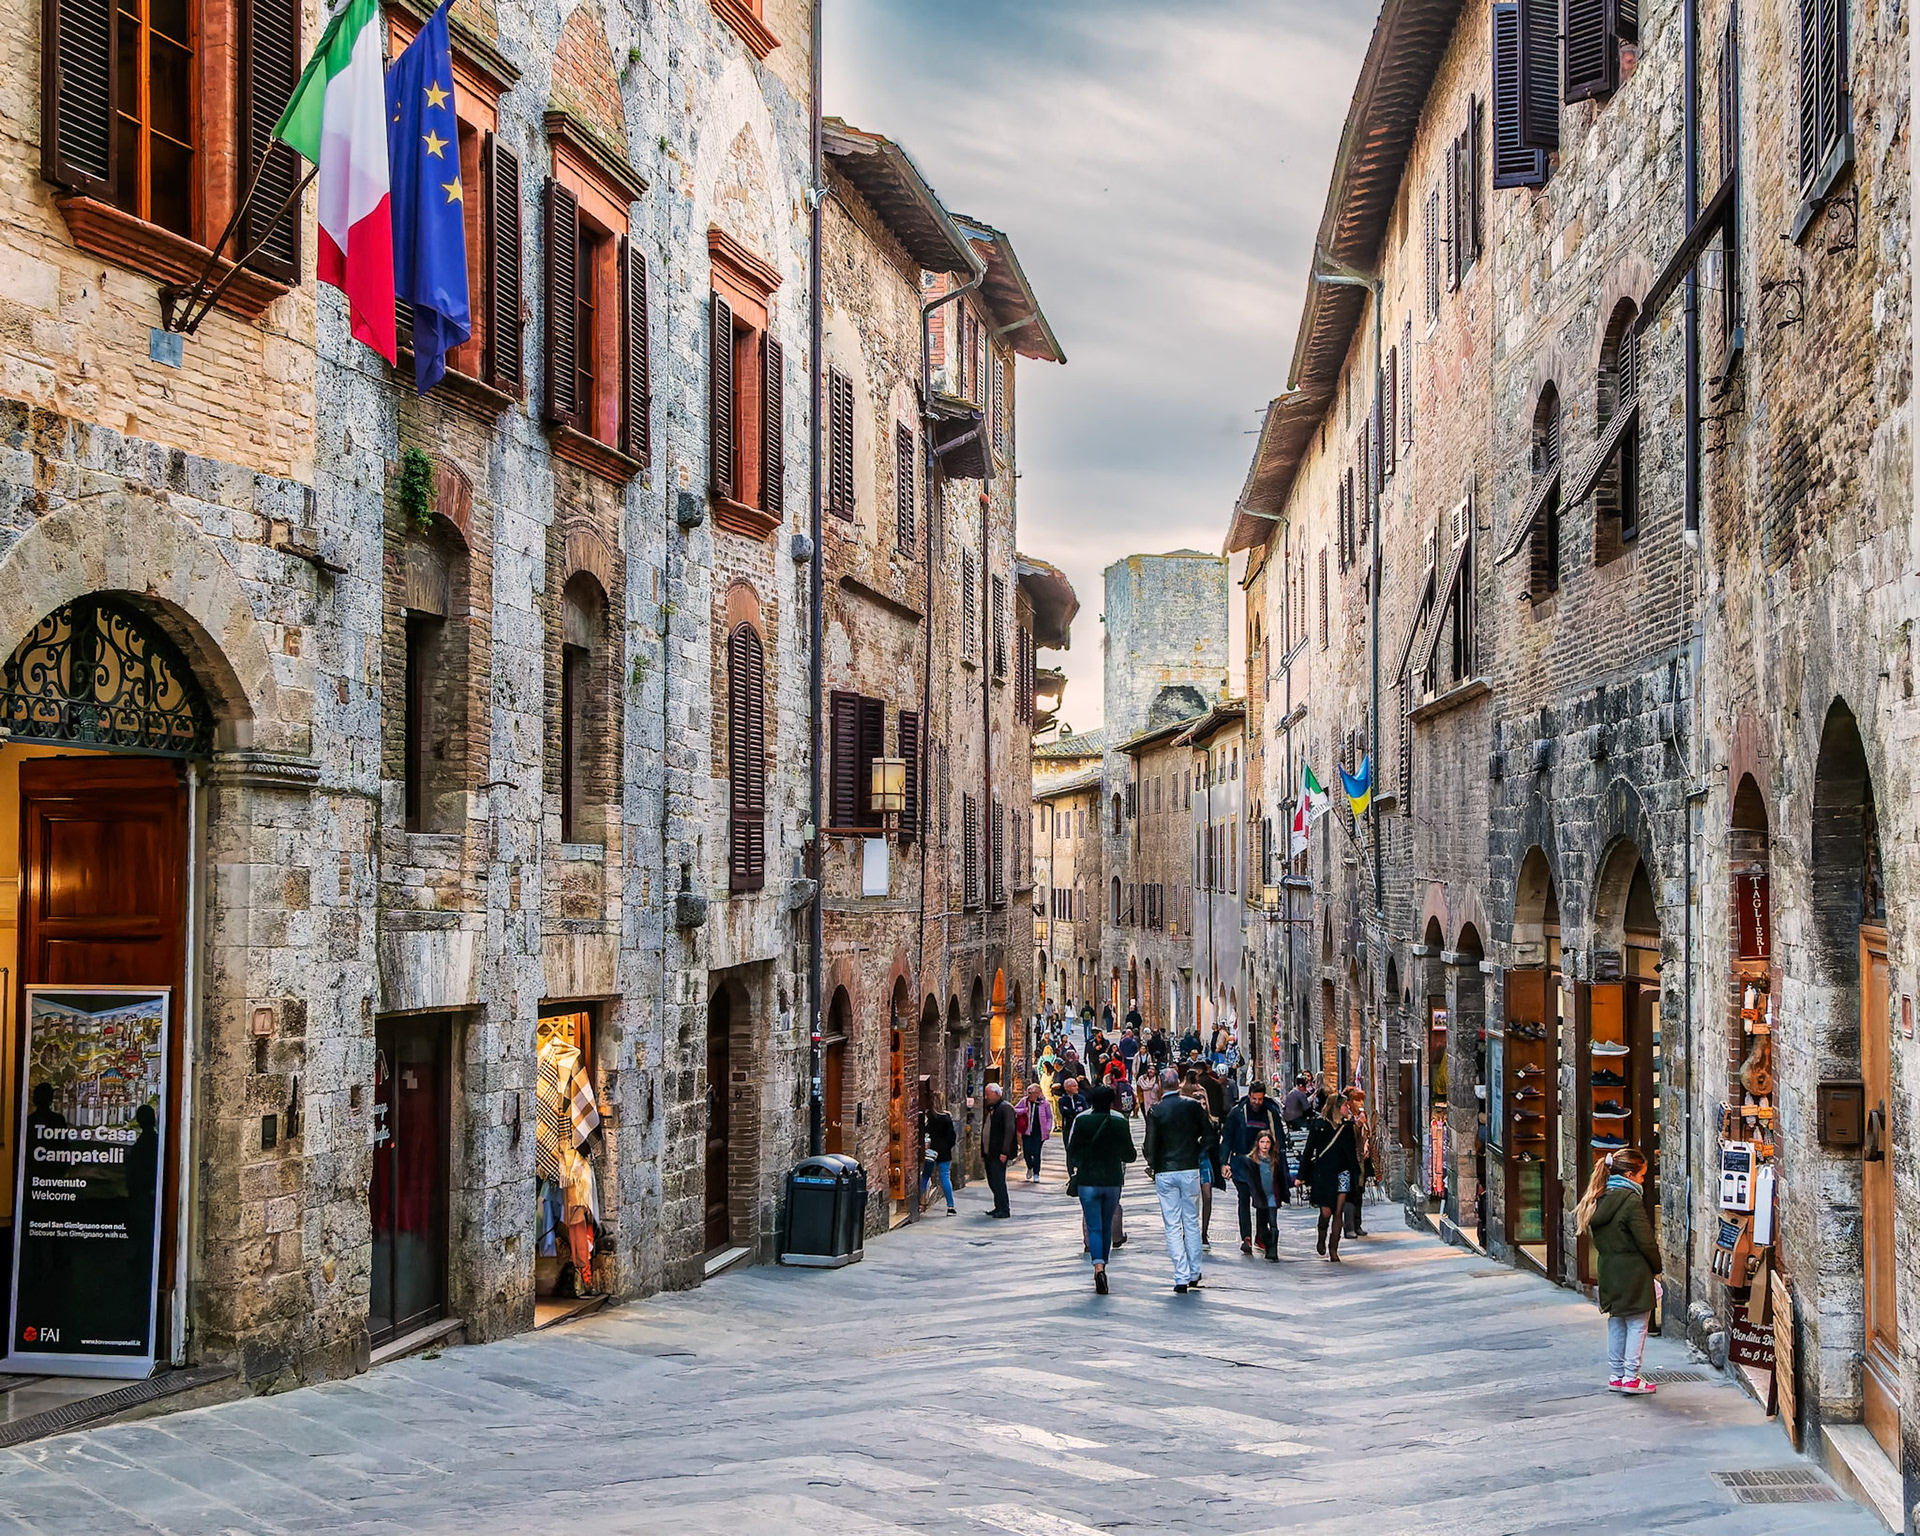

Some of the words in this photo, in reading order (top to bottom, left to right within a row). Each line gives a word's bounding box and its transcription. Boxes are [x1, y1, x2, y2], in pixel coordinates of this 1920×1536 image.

[1749, 876, 1765, 956] TAGLIERI
[35, 1124, 78, 1140] Torre
[81, 1128, 92, 1140] e
[95, 1126, 137, 1141] Casa
[33, 1146, 124, 1165] Campatelli
[32, 1177, 87, 1187] Benvenuto
[31, 1190, 76, 1201] Welcome
[64, 1222, 100, 1230] Gimignano
[69, 1230, 104, 1239] Gimignano
[40, 1327, 60, 1342] FAI
[1732, 1328, 1761, 1344] Vendita
